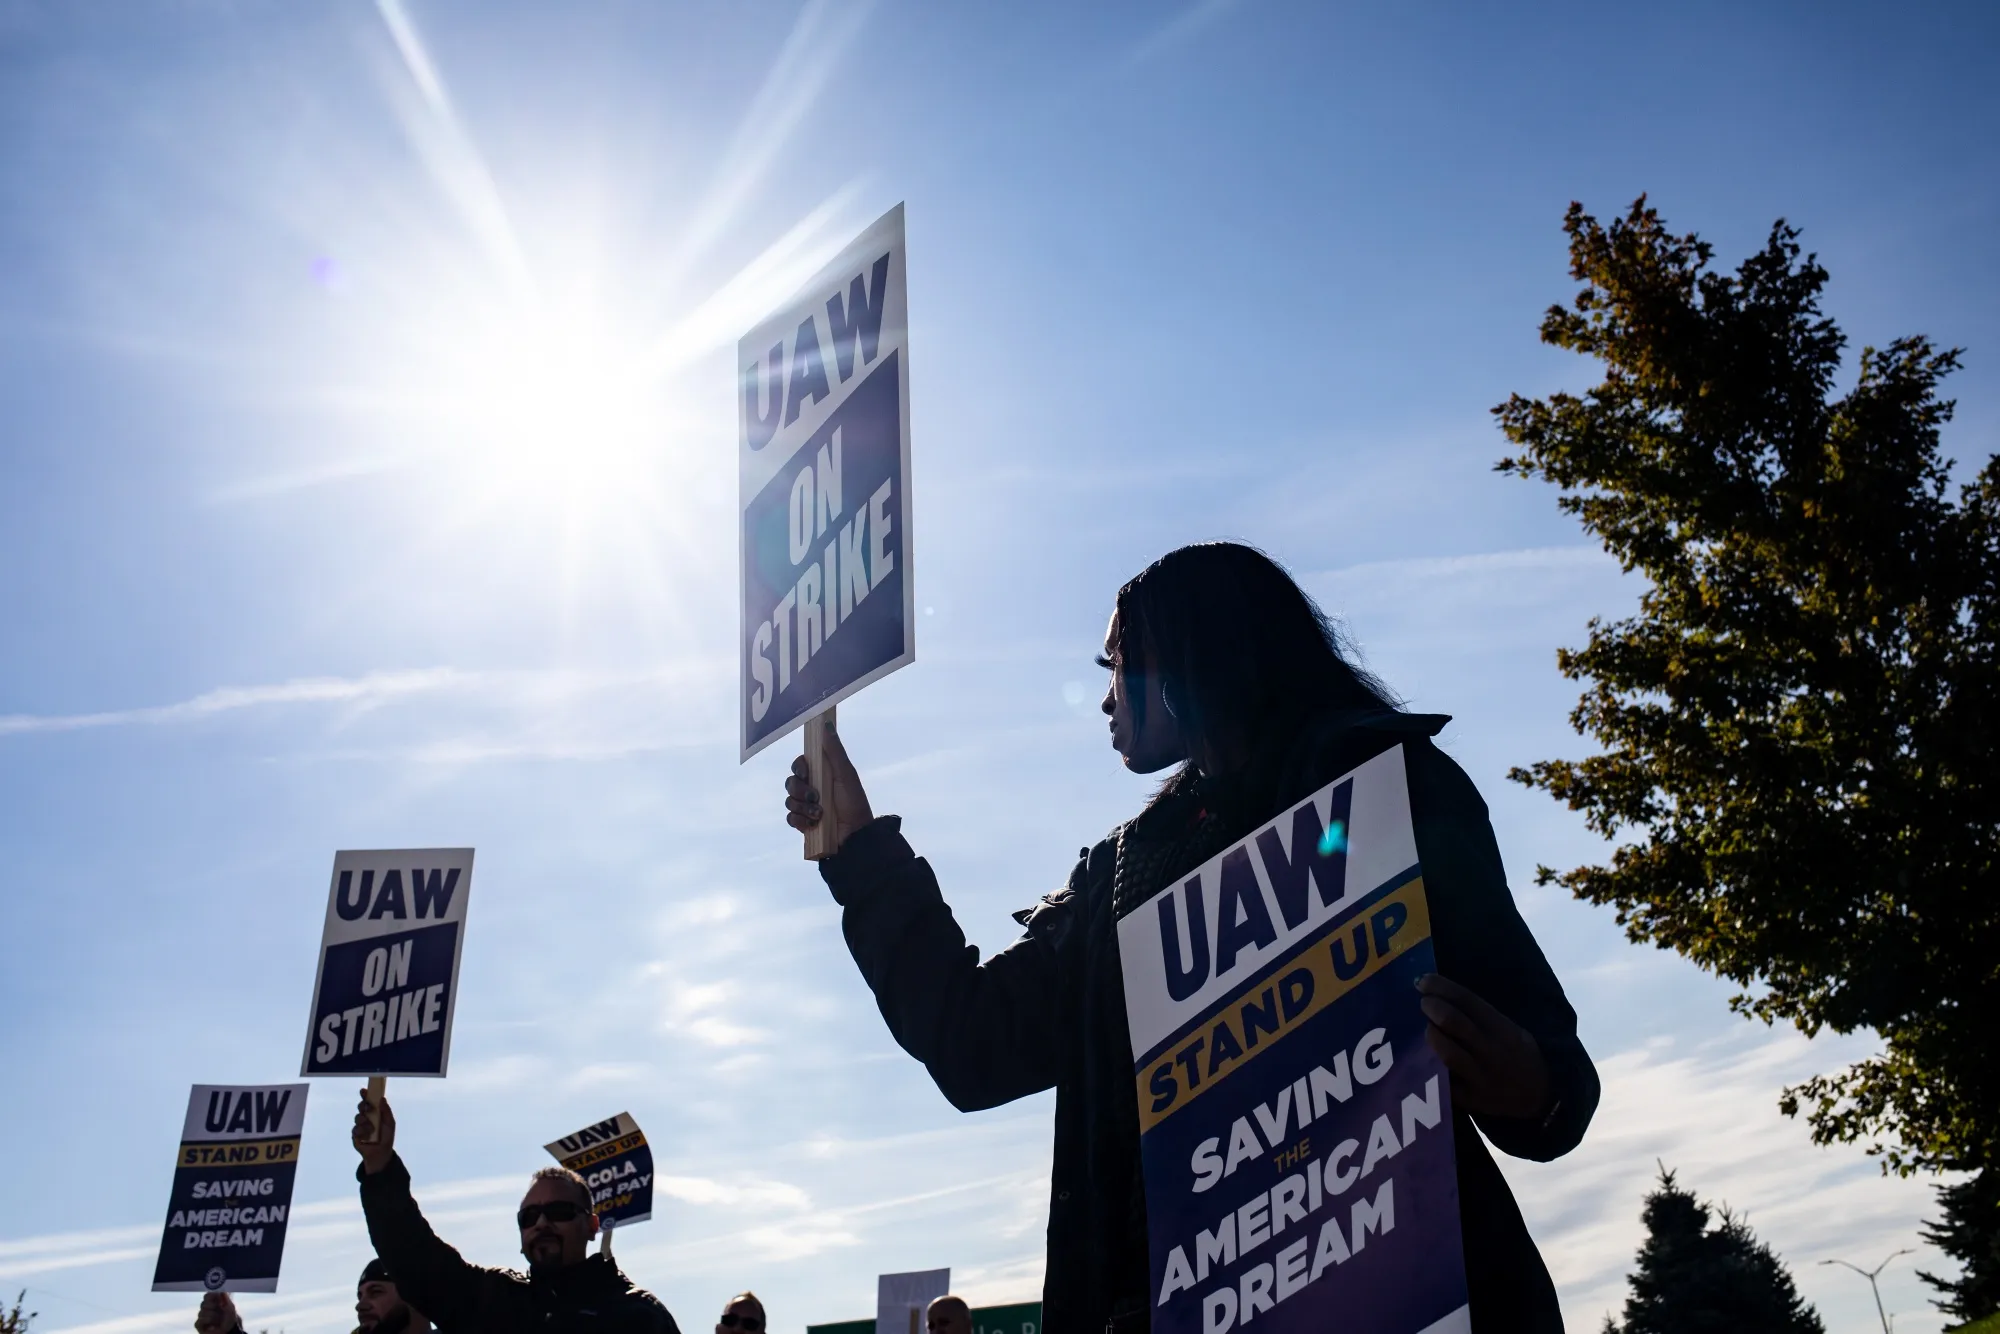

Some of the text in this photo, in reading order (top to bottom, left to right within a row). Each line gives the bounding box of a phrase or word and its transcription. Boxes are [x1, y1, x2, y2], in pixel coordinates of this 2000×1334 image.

[745, 251, 891, 452] UAW
[789, 424, 842, 567] ON
[751, 476, 893, 724] STRIKE
[336, 867, 462, 922] UAW
[1157, 775, 1355, 1003] UAW
[361, 939, 413, 998] ON
[316, 982, 444, 1064] STRIKE
[1150, 901, 1409, 1113] STAND UP
[205, 1089, 291, 1133] UAW
[557, 1117, 622, 1153] UAW
[1190, 1027, 1395, 1194] SAVING
[184, 1143, 293, 1165] STAND UP
[620, 1134, 641, 1148] UP
[1273, 1138, 1311, 1174] THE
[191, 1178, 274, 1199] SAVING
[587, 1160, 637, 1188] COLA
[592, 1173, 652, 1204] IR PAY
[1157, 1074, 1442, 1308] AMERICAN
[169, 1205, 286, 1228] AMERICAN
[183, 1228, 264, 1249] DREAM
[1202, 1177, 1396, 1334] DREAM
